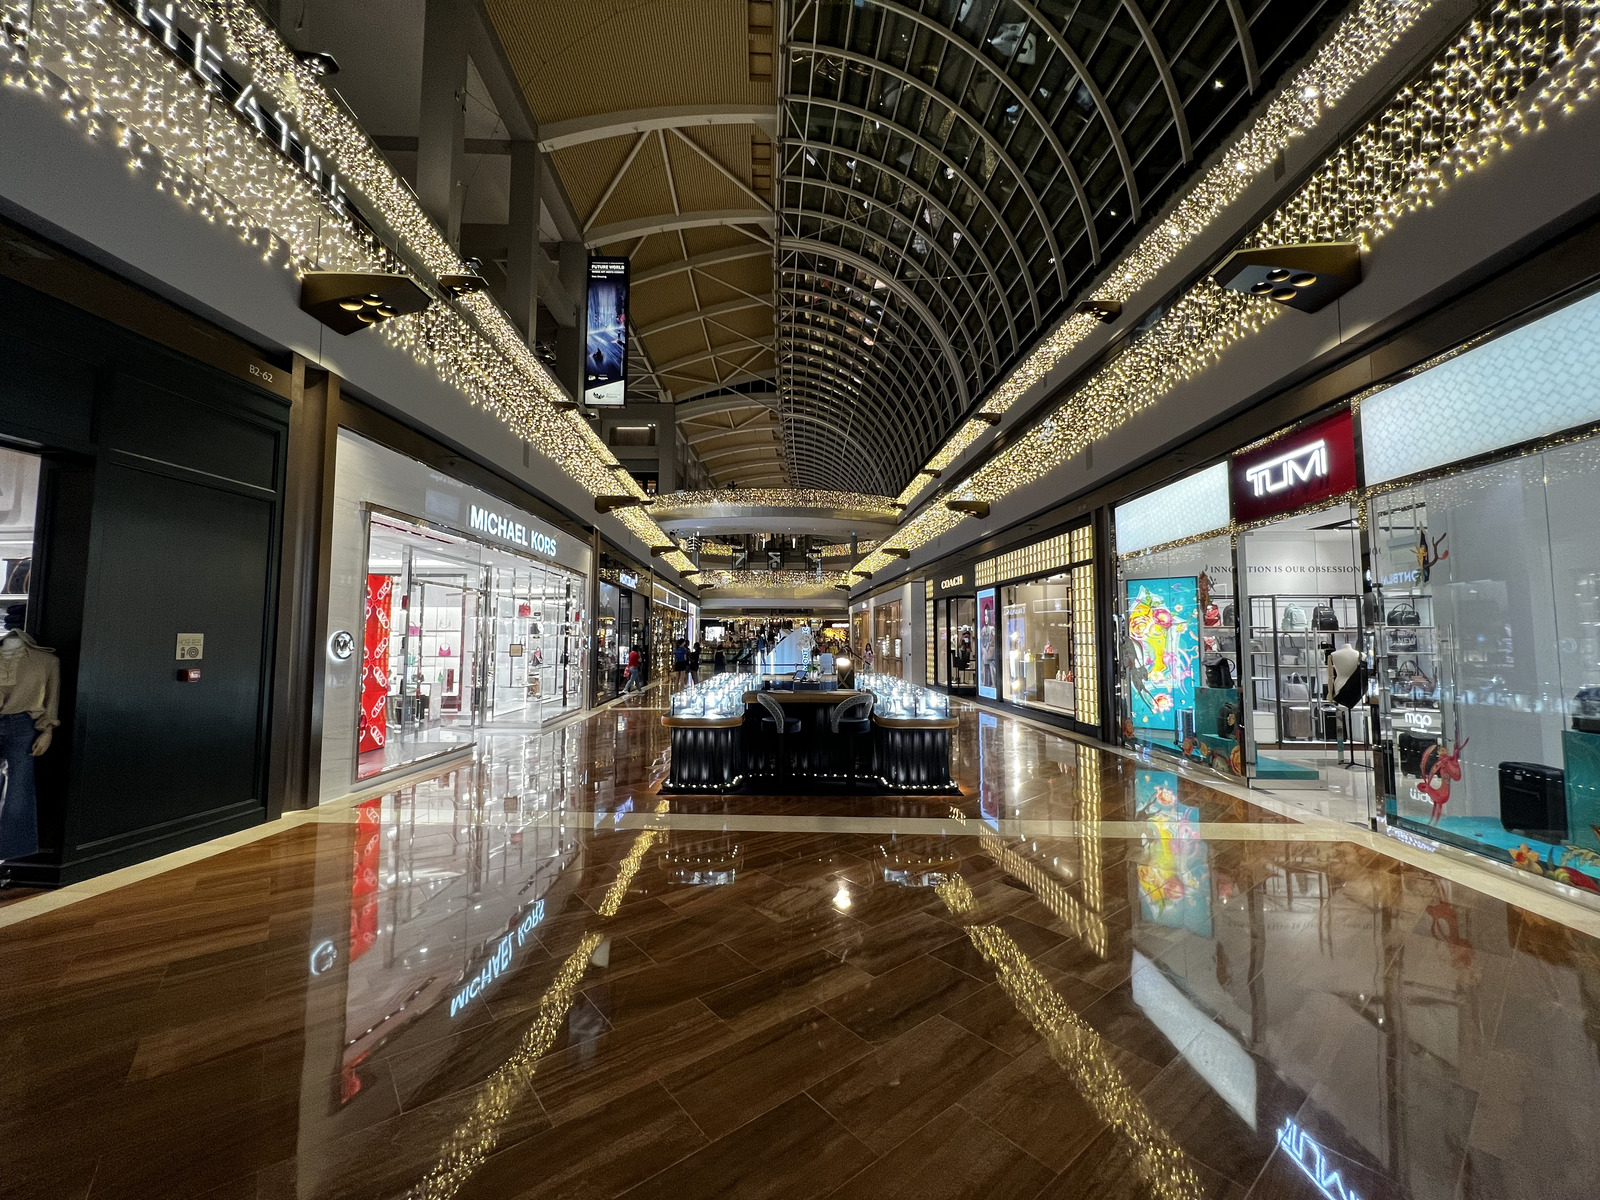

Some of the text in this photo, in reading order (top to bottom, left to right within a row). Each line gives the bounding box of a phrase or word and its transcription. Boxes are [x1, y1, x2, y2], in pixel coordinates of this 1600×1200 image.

[249, 364, 273, 383] B2-62
[1246, 439, 1328, 497] TUMI
[470, 505, 557, 557] MICHAEL KORS
[941, 575, 964, 590] COACH
